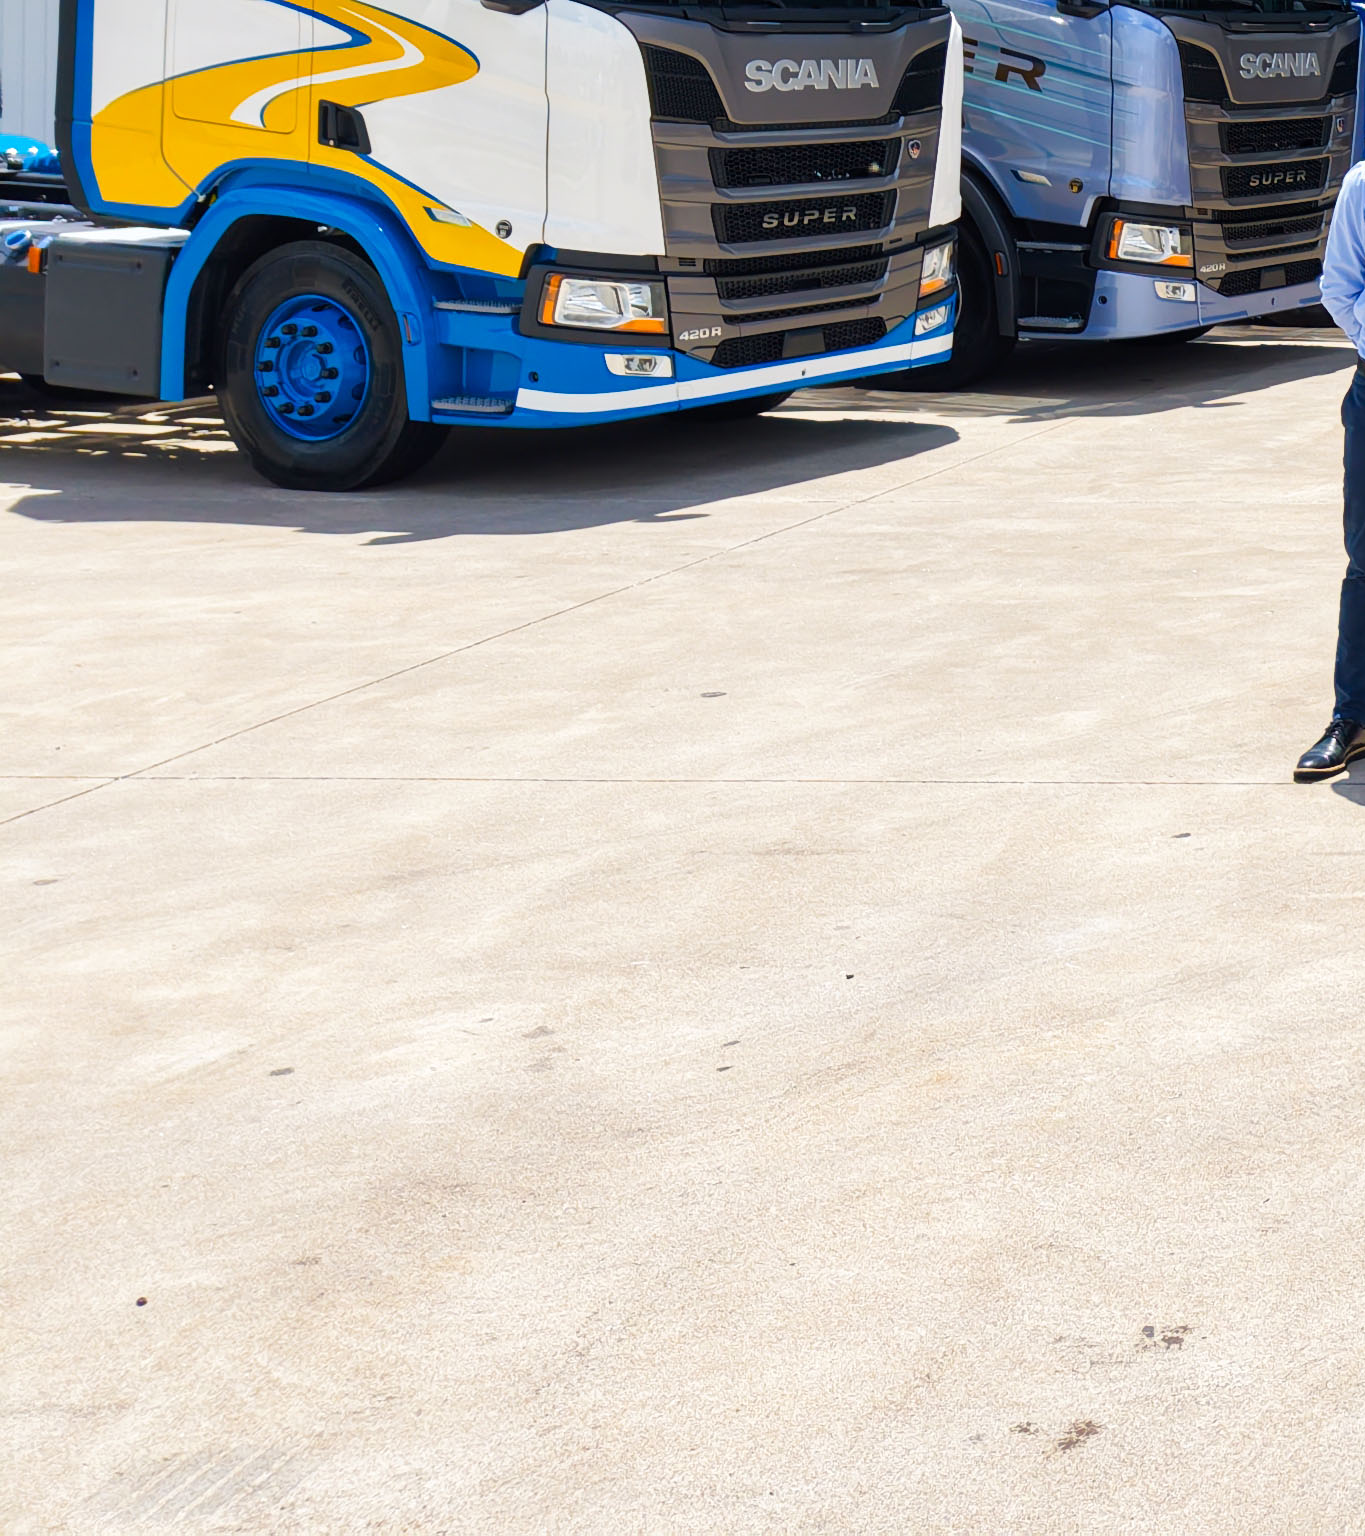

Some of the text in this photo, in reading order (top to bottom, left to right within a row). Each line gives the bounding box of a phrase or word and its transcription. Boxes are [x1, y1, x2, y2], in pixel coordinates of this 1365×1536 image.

[744, 58, 880, 93] SCANIA
[1239, 52, 1321, 80] SCANIA
[1250, 169, 1307, 187] SUPER
[761, 206, 858, 230] SUPER
